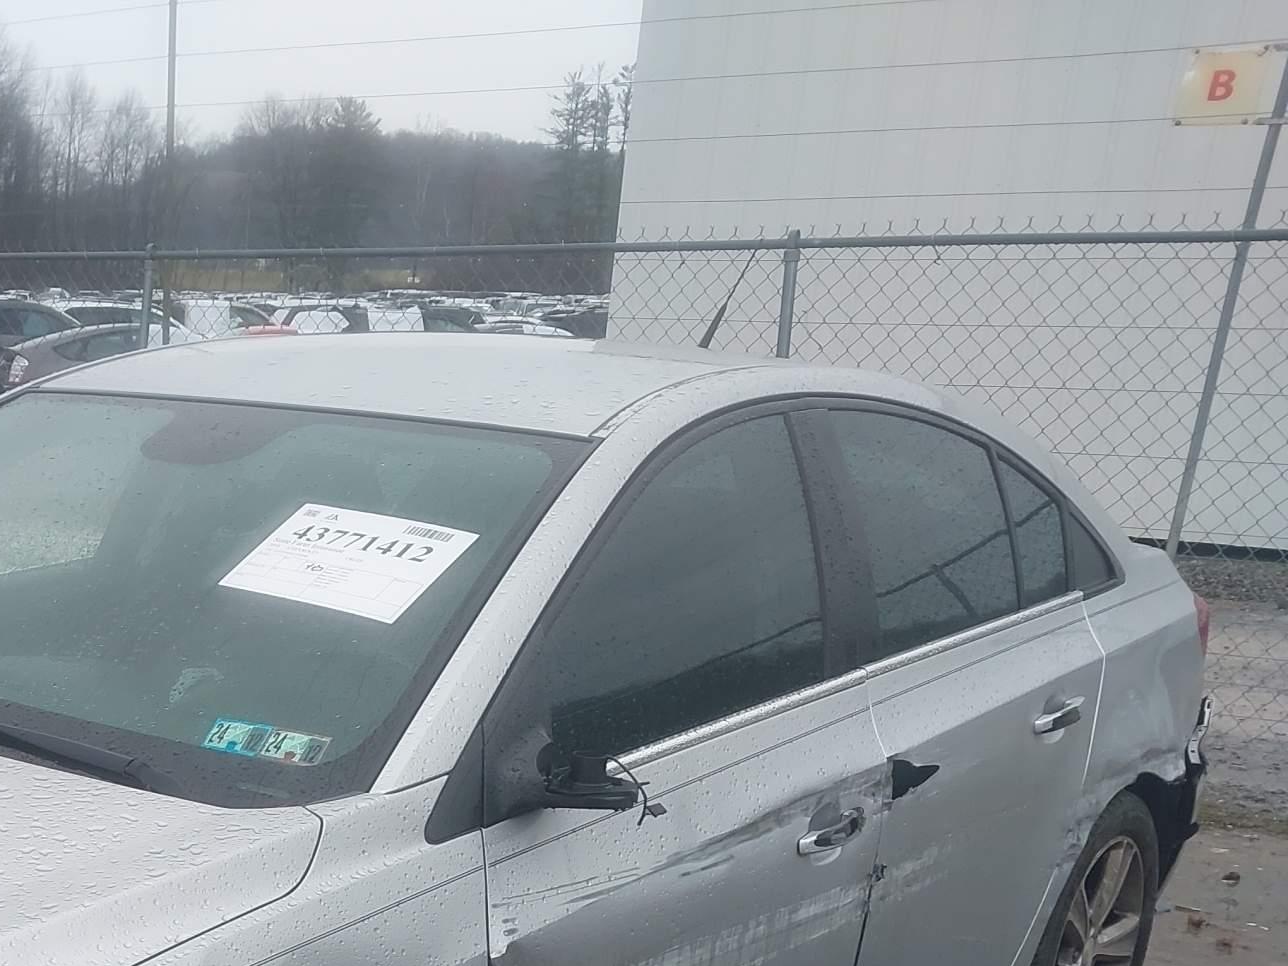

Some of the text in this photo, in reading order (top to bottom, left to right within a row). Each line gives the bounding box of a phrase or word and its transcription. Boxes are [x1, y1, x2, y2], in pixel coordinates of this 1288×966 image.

[1208, 70, 1236, 101] B
[292, 525, 435, 562] 43771412
[208, 723, 231, 743] 24
[265, 732, 288, 754] 24
